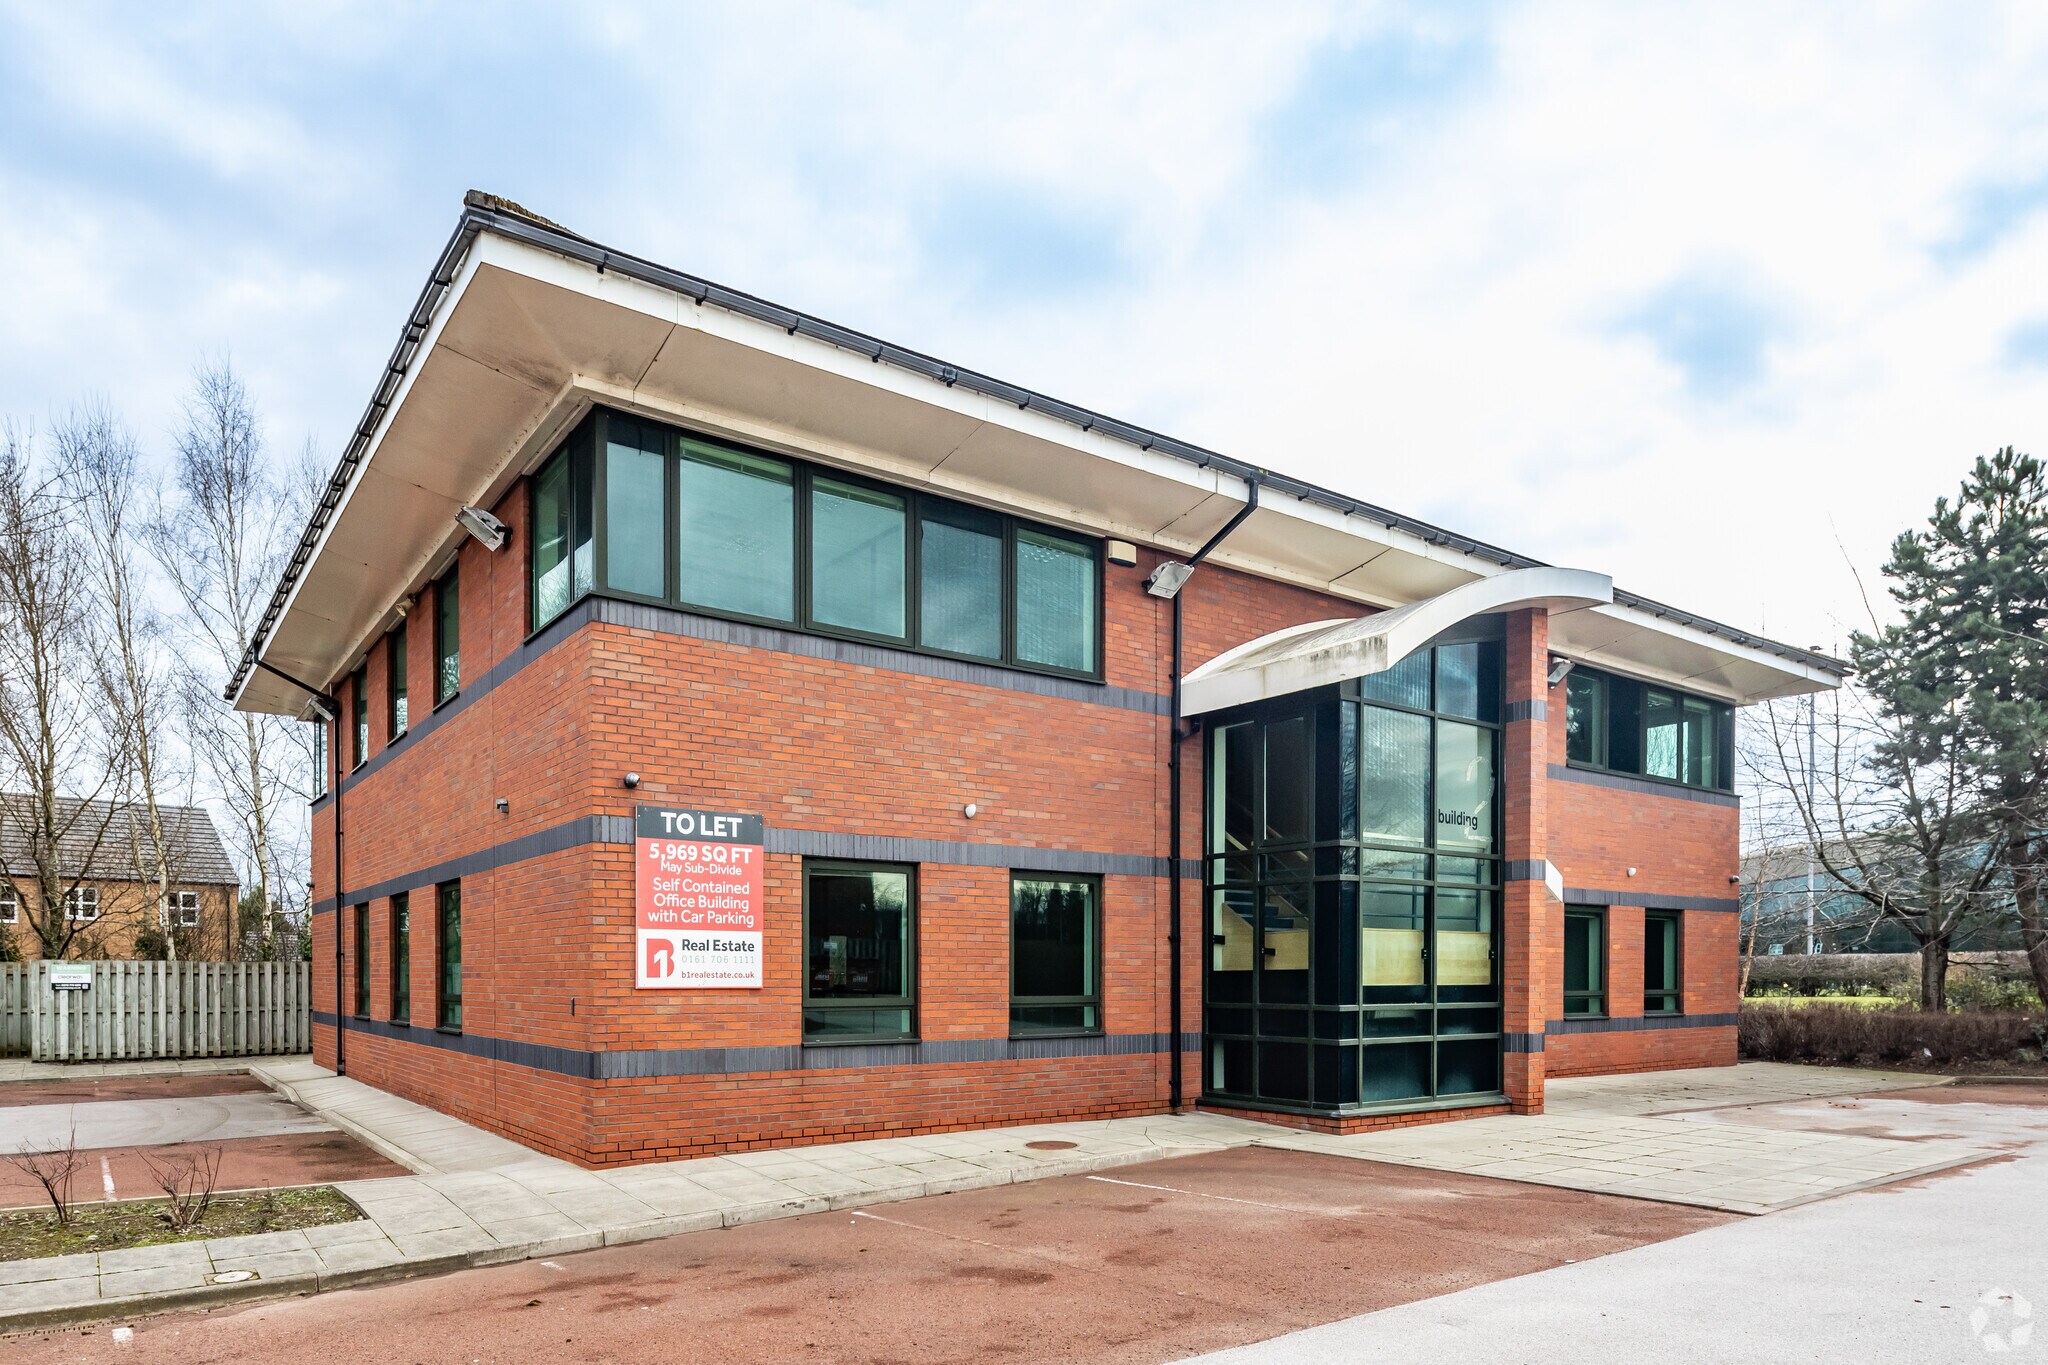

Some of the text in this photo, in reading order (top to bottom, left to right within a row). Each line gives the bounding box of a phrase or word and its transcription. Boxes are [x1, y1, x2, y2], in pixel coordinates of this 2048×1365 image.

[661, 812, 742, 838] TO LET
[1438, 808, 1478, 830] building
[649, 843, 752, 864] 5,969 SQ FT
[661, 861, 742, 875] May Sub-Divide
[653, 877, 749, 895] Self Contained
[654, 893, 749, 912] Office Building
[648, 909, 754, 928] with Car Parking
[682, 939, 755, 952] Real Estate
[733, 956, 754, 964] 1111
[681, 971, 755, 979] b1realestate.co.uk
